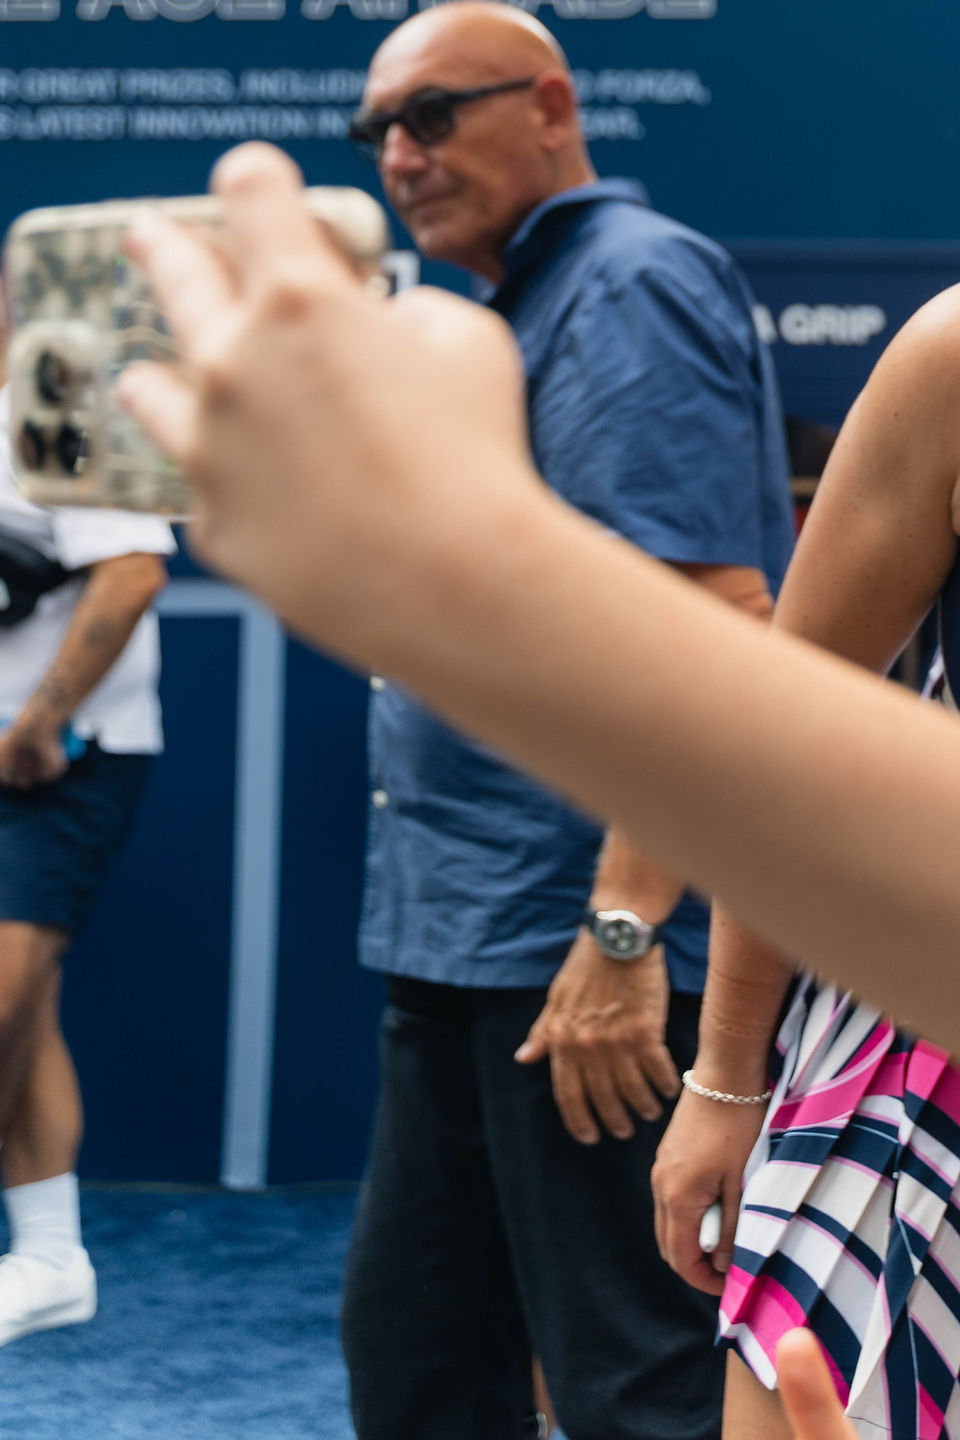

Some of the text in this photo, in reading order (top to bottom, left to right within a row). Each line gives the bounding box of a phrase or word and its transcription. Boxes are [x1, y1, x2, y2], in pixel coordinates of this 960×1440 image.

[19, 68, 119, 101] GREAT
[16, 106, 127, 140] LATEST
[129, 106, 312, 140] INNOVATION
[779, 303, 887, 345] GRIP
